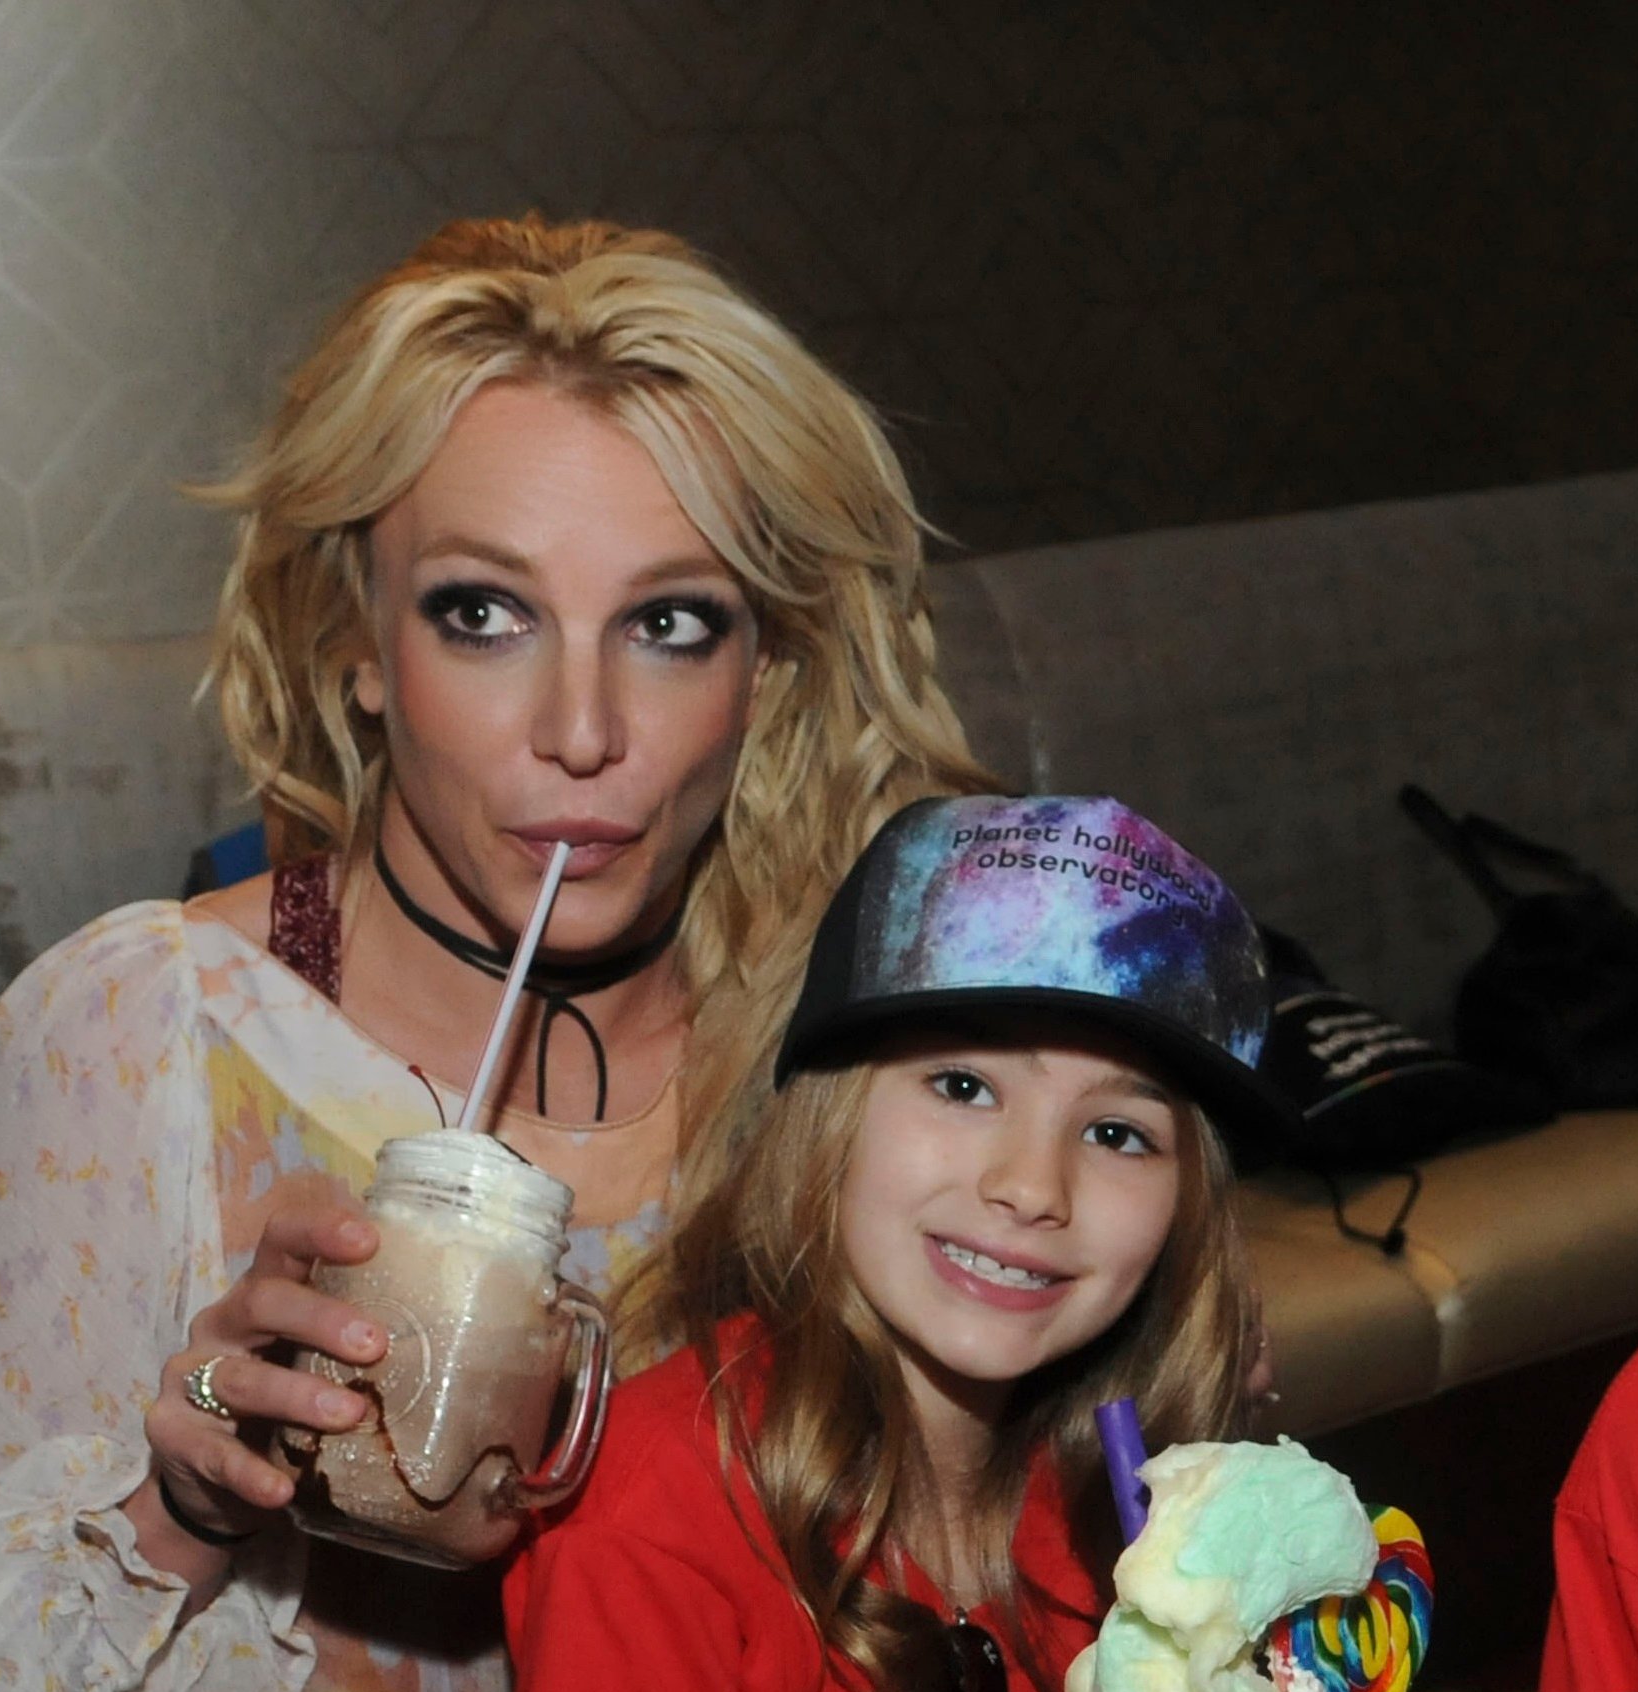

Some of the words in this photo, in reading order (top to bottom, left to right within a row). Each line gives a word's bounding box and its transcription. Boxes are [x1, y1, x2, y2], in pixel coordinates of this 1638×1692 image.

[952, 824, 1062, 849] planet
[1073, 825, 1212, 911] hollywood
[978, 848, 1187, 928] observatory
